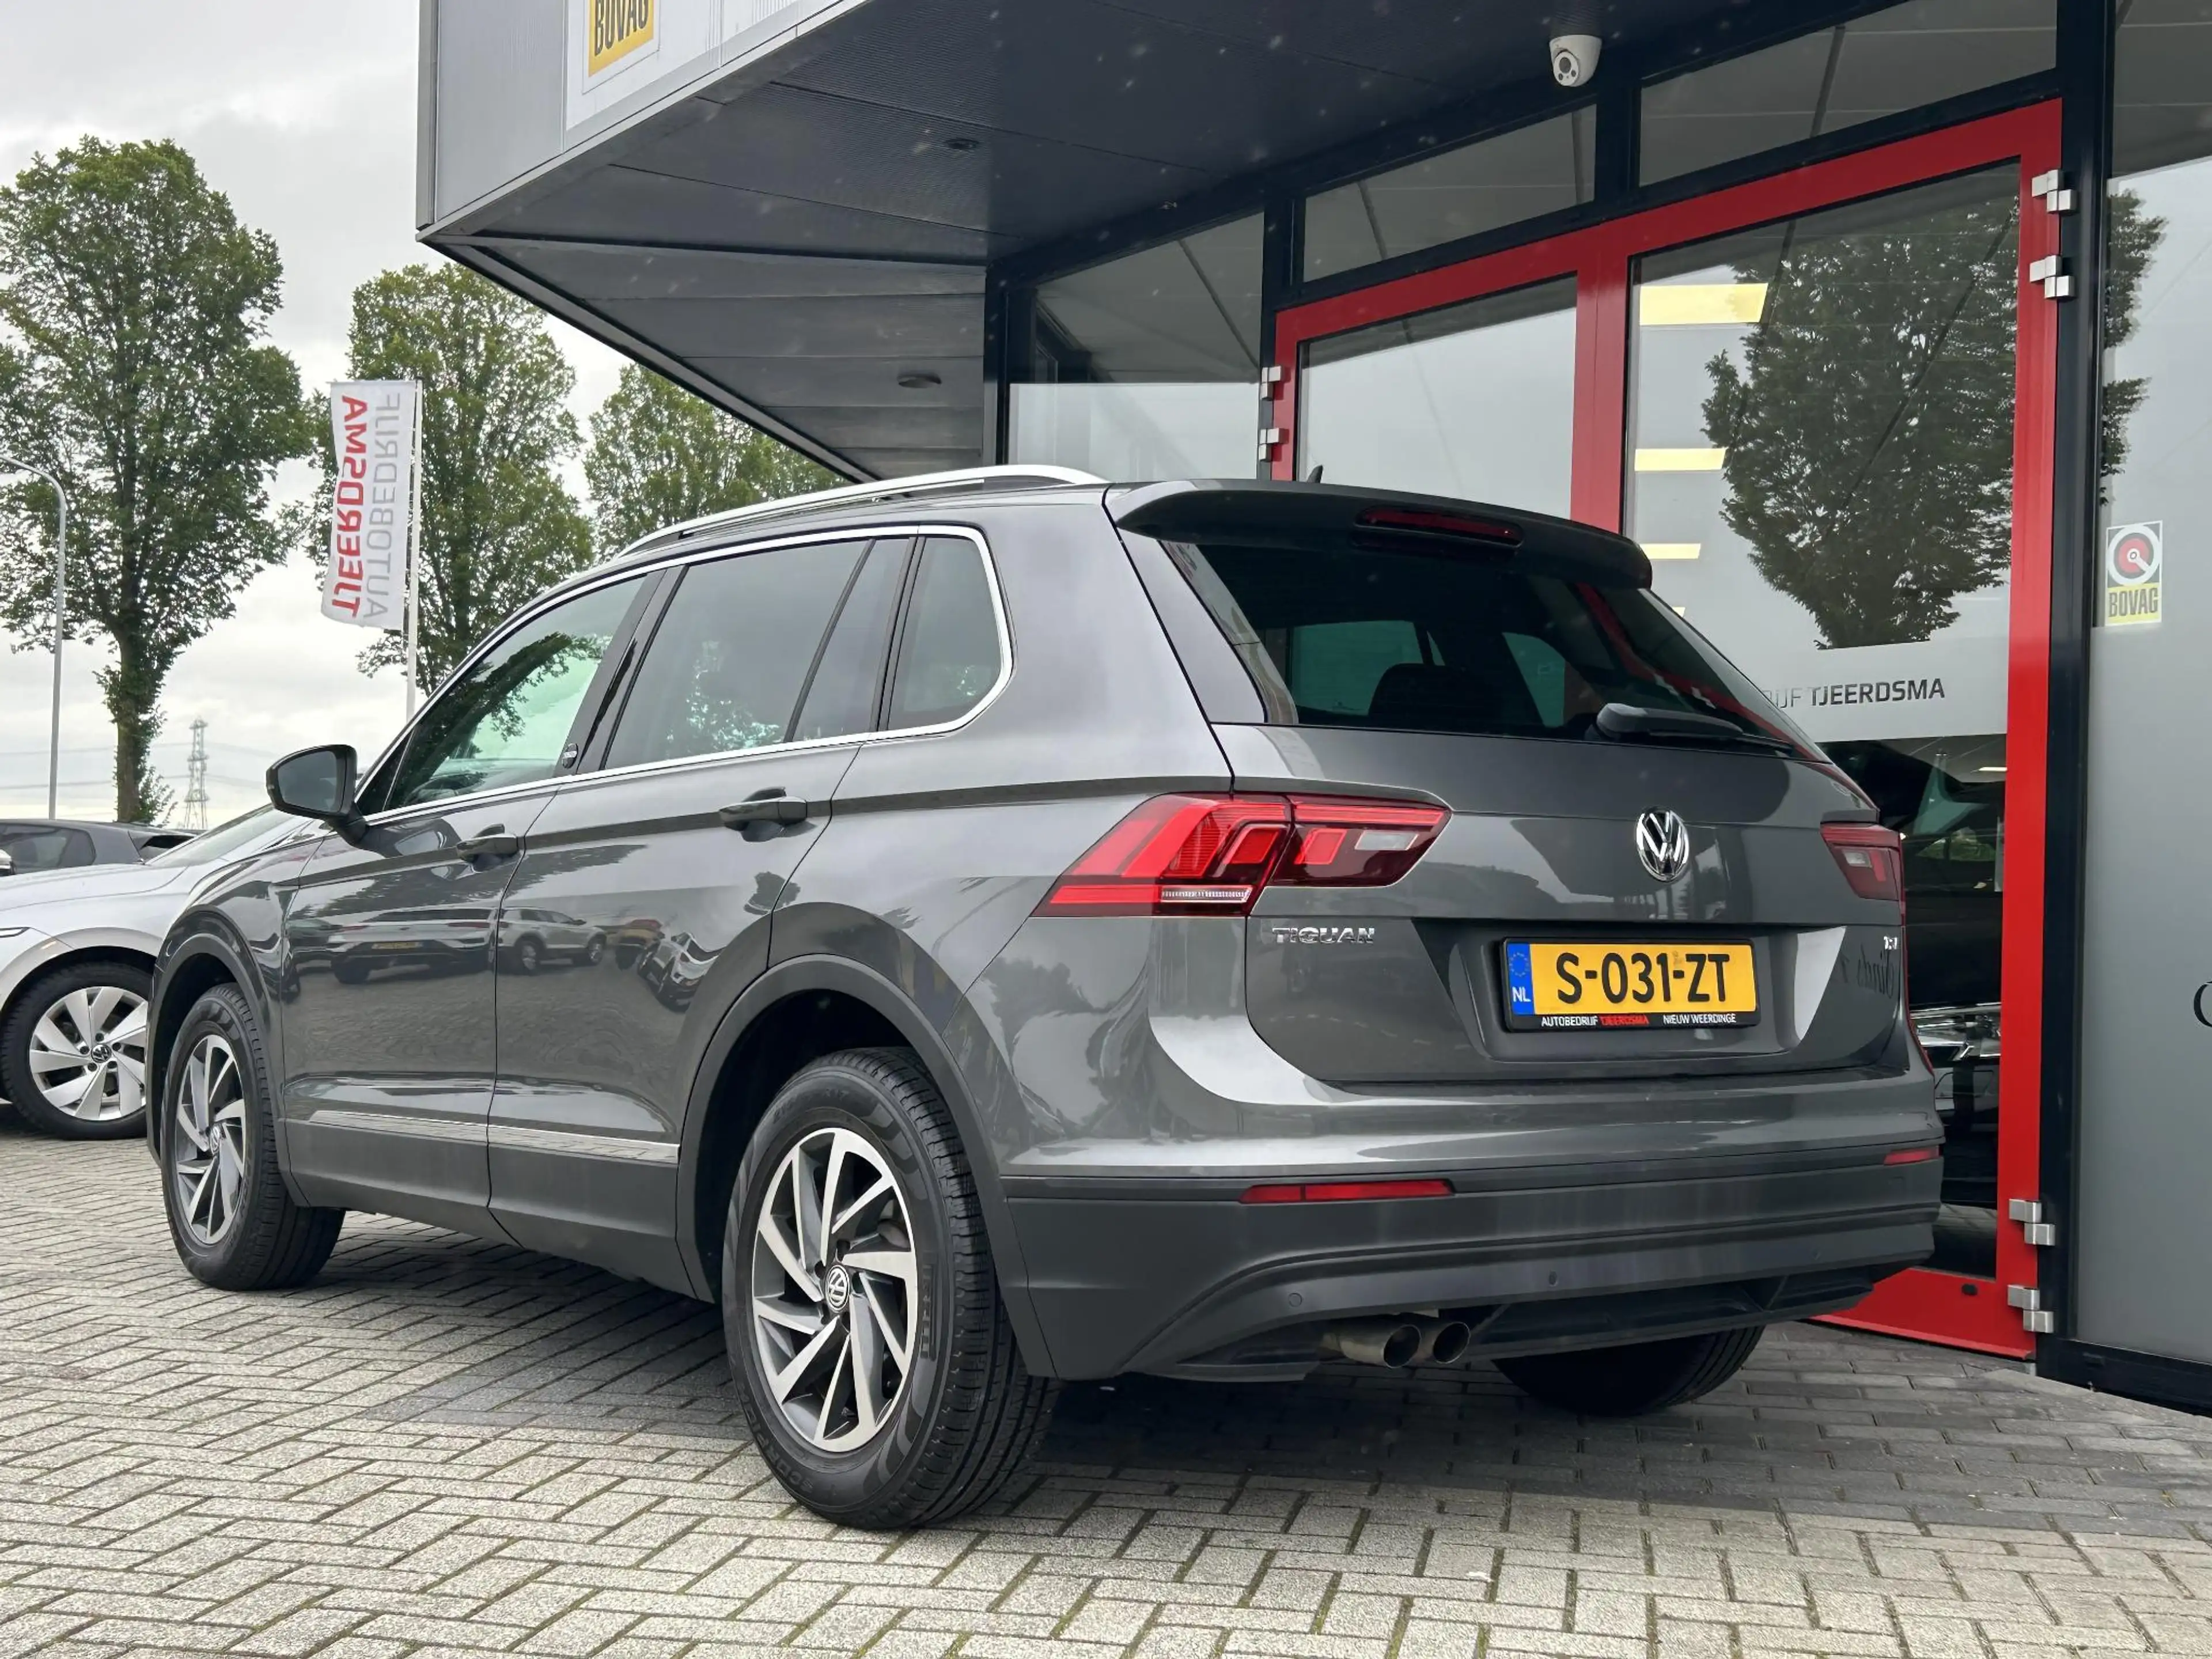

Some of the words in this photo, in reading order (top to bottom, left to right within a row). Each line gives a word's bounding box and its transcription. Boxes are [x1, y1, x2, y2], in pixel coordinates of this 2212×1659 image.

[2108, 588, 2158, 617] BOVAG
[1807, 678, 1945, 706] TJEERDSMA
[1272, 927, 1375, 944] TIGUAN
[1556, 952, 1730, 1004] S-031-ZT
[1512, 987, 1531, 1002] NL
